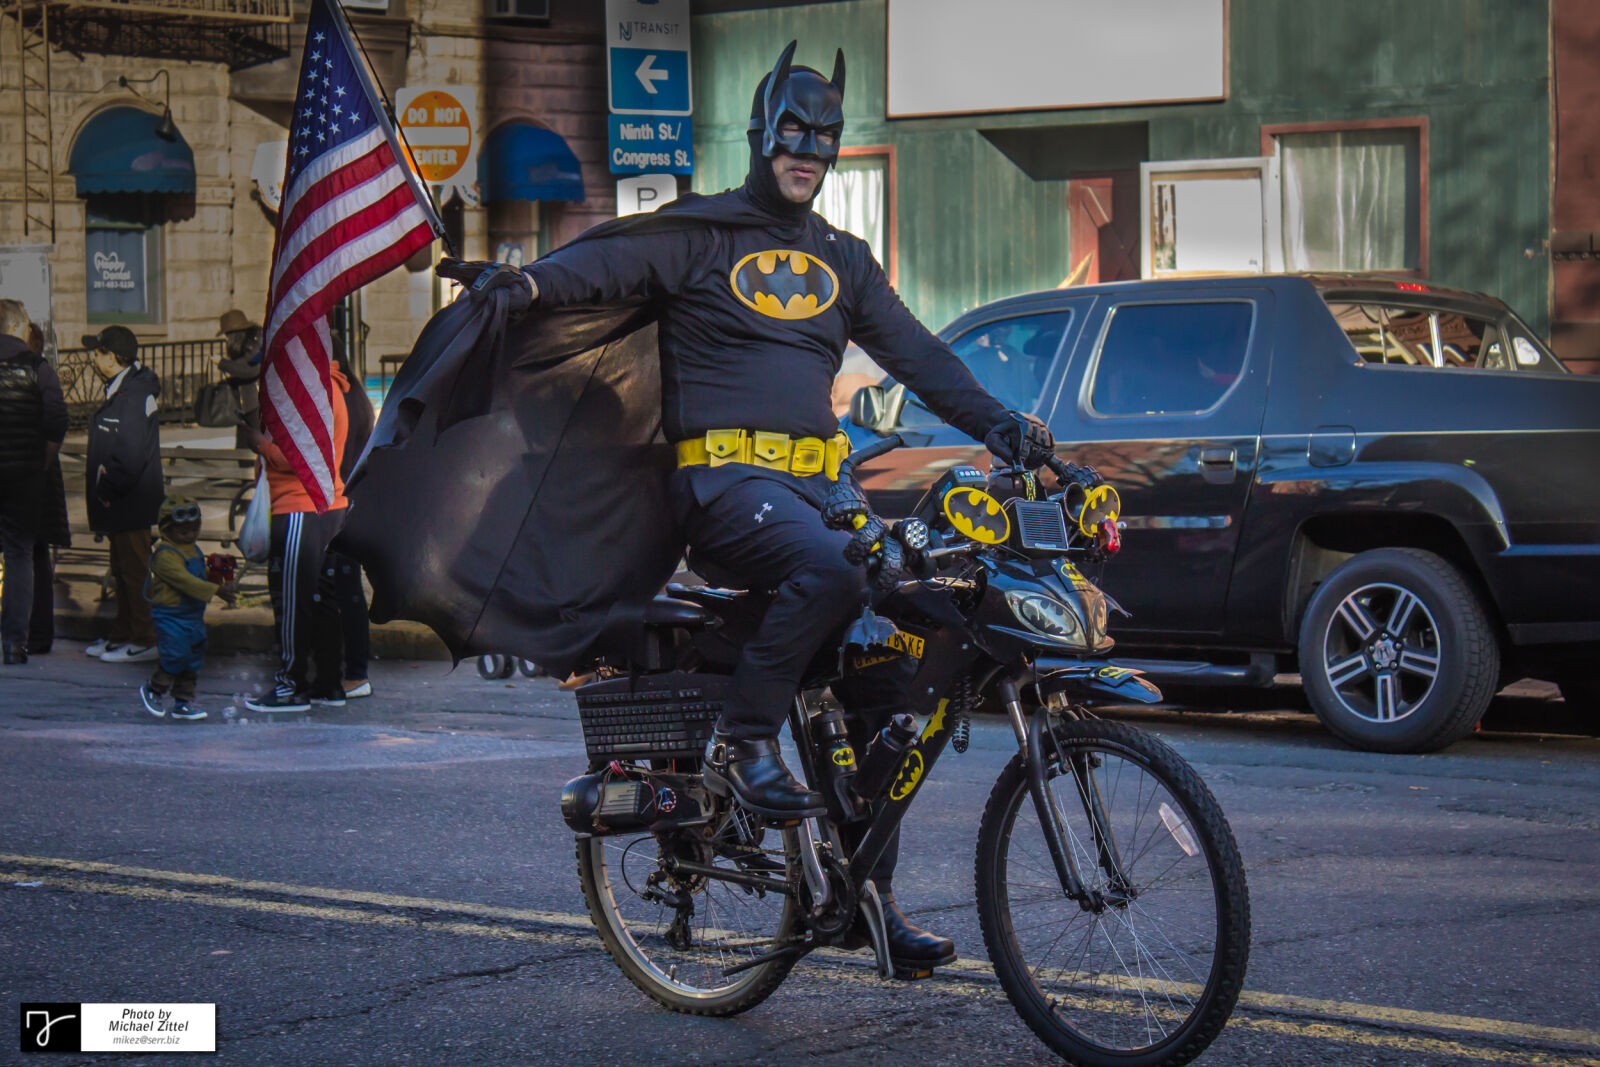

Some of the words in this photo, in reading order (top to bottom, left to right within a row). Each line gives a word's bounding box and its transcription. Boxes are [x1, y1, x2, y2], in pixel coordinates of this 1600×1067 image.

[633, 21, 679, 35] TRANSIT
[407, 107, 428, 124] DO
[434, 107, 462, 123] NOT
[619, 123, 654, 141] Ninth
[413, 148, 457, 165] ENTER
[612, 147, 671, 169] Congress
[674, 149, 691, 167] St.
[636, 186, 658, 211] P
[102, 269, 131, 280] Dental
